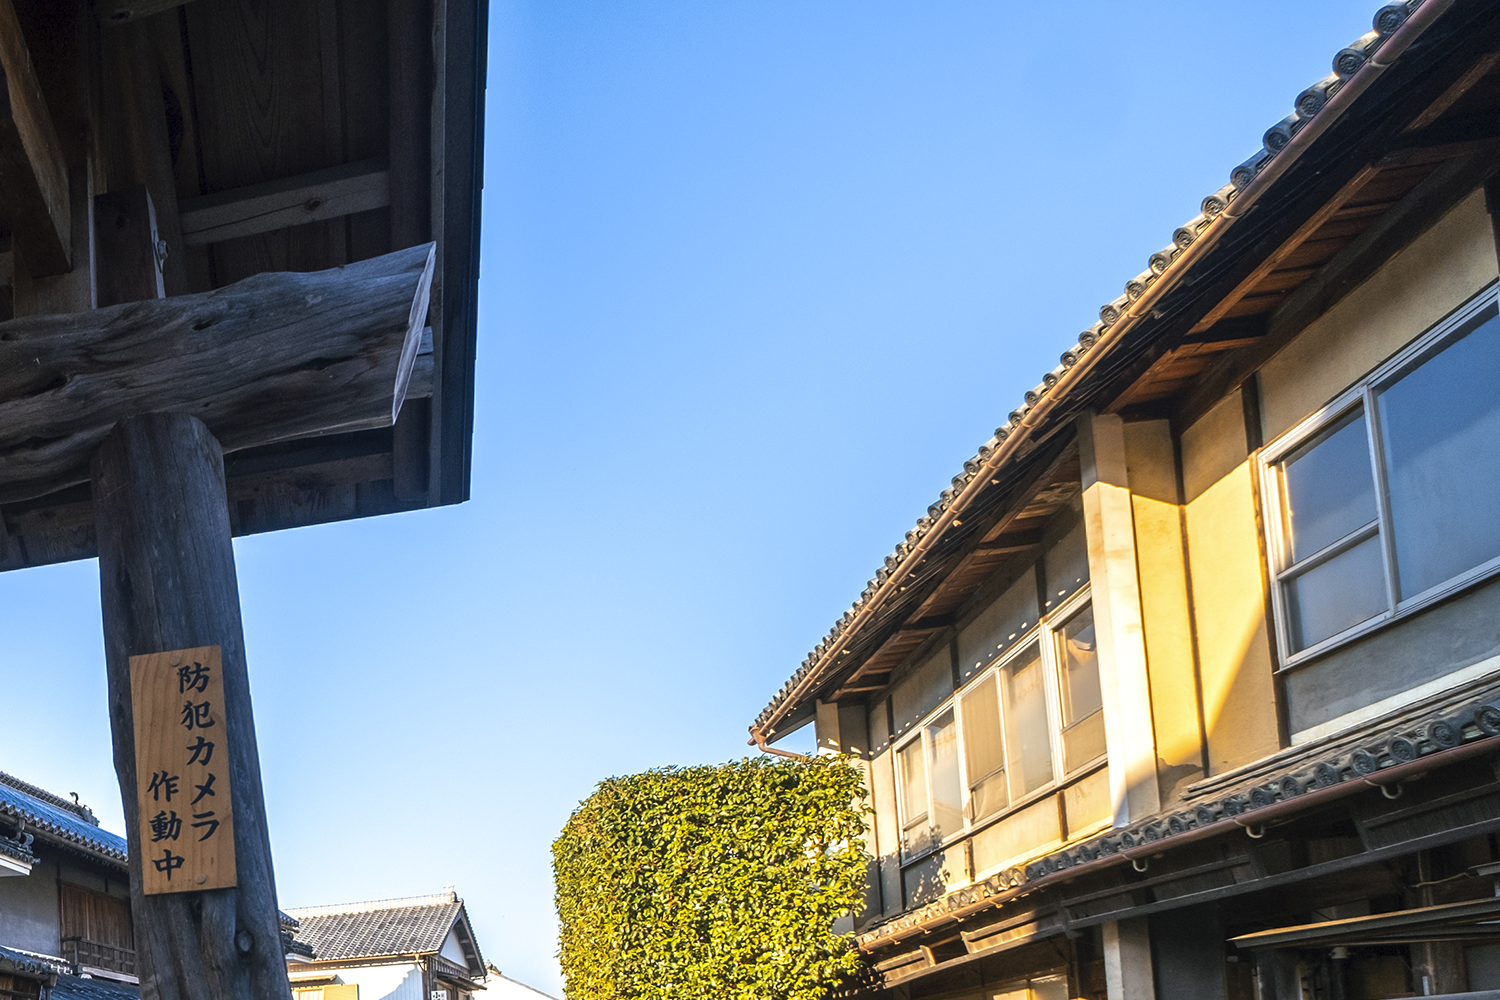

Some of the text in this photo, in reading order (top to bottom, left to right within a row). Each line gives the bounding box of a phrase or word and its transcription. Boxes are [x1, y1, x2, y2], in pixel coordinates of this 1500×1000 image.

[176, 661, 220, 842] 防犯カメラ
[147, 770, 186, 882] 作動中
